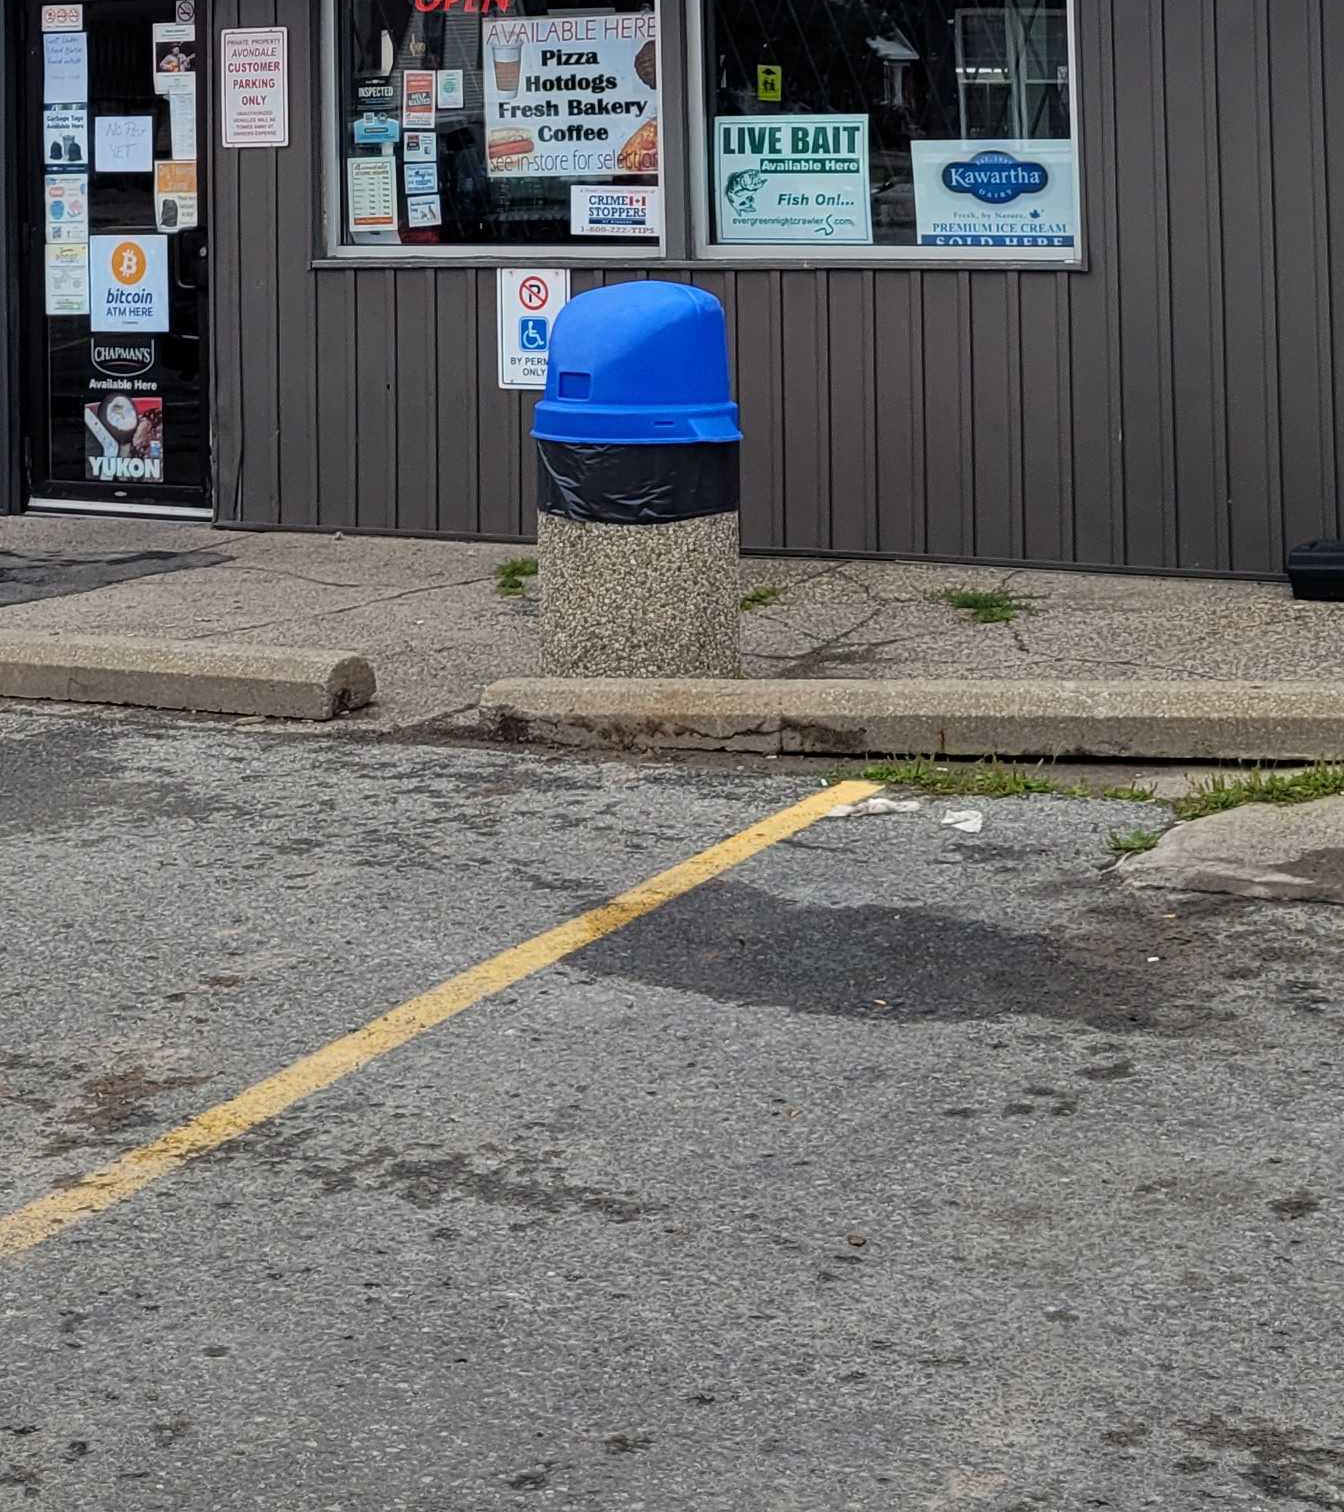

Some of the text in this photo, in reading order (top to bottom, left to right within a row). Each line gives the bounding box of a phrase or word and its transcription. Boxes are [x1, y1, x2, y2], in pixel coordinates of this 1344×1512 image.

[486, 17, 656, 44] AVAILABLE HERE
[232, 47, 277, 58] AVONDALE
[541, 49, 599, 67] Pizza
[228, 61, 281, 73] CUSTOMER
[233, 78, 275, 89] PARKING
[525, 74, 617, 93] Hotdogs
[241, 95, 267, 106] ONLY
[498, 99, 647, 118] Fresh Bakery
[537, 125, 608, 142] Coffee
[723, 126, 860, 154] LIVE BAIT
[517, 152, 568, 171] in-store
[573, 149, 594, 170] for
[761, 160, 858, 171] Available Here
[950, 167, 1040, 187] Kawartha
[588, 195, 628, 206] CRIME
[777, 194, 809, 206] Fish
[588, 207, 647, 217] STOPPERS
[932, 224, 1067, 233] PREMIUM ICE CREAM
[106, 288, 153, 304] bitcoin
[106, 307, 154, 317] ATM HERE
[94, 346, 151, 362] CHAPMAN'S
[510, 357, 522, 366] BY
[522, 368, 545, 377] ONLY
[89, 378, 158, 391] Available Here
[88, 457, 161, 481] YUKON
